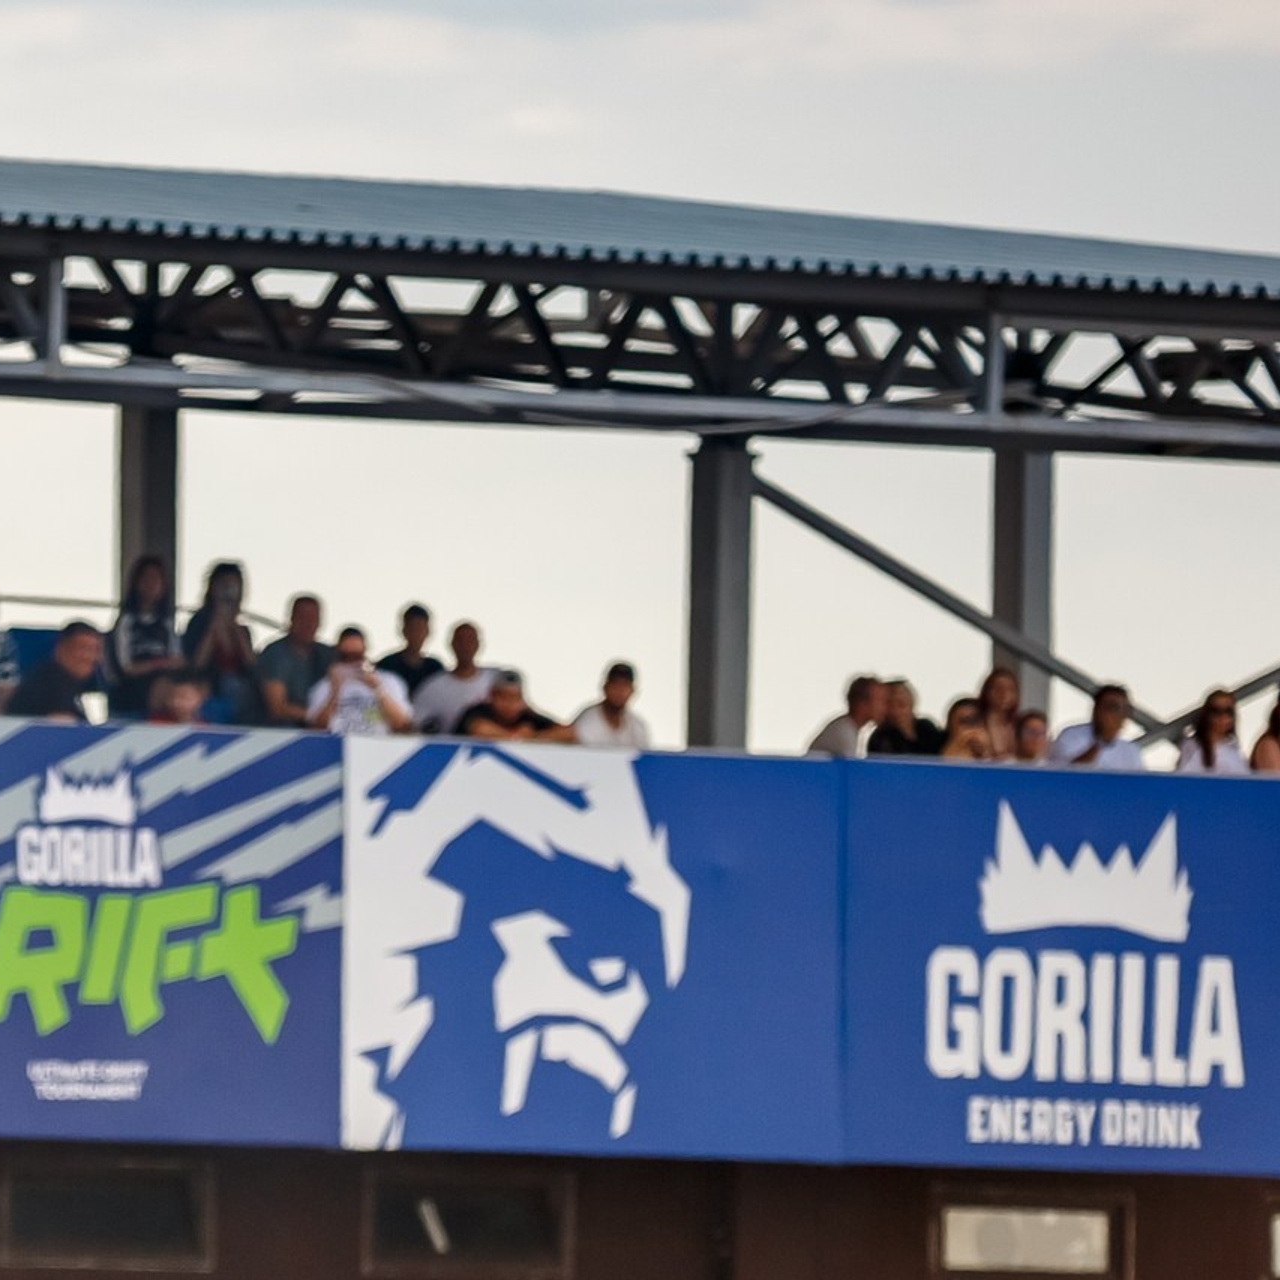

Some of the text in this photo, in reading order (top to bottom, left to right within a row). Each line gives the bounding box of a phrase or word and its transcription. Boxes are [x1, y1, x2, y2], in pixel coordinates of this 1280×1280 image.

[17, 828, 163, 887] GORILLA
[926, 945, 1245, 1088] GORILLA
[967, 1096, 1201, 1149] ENERGY DRINK
